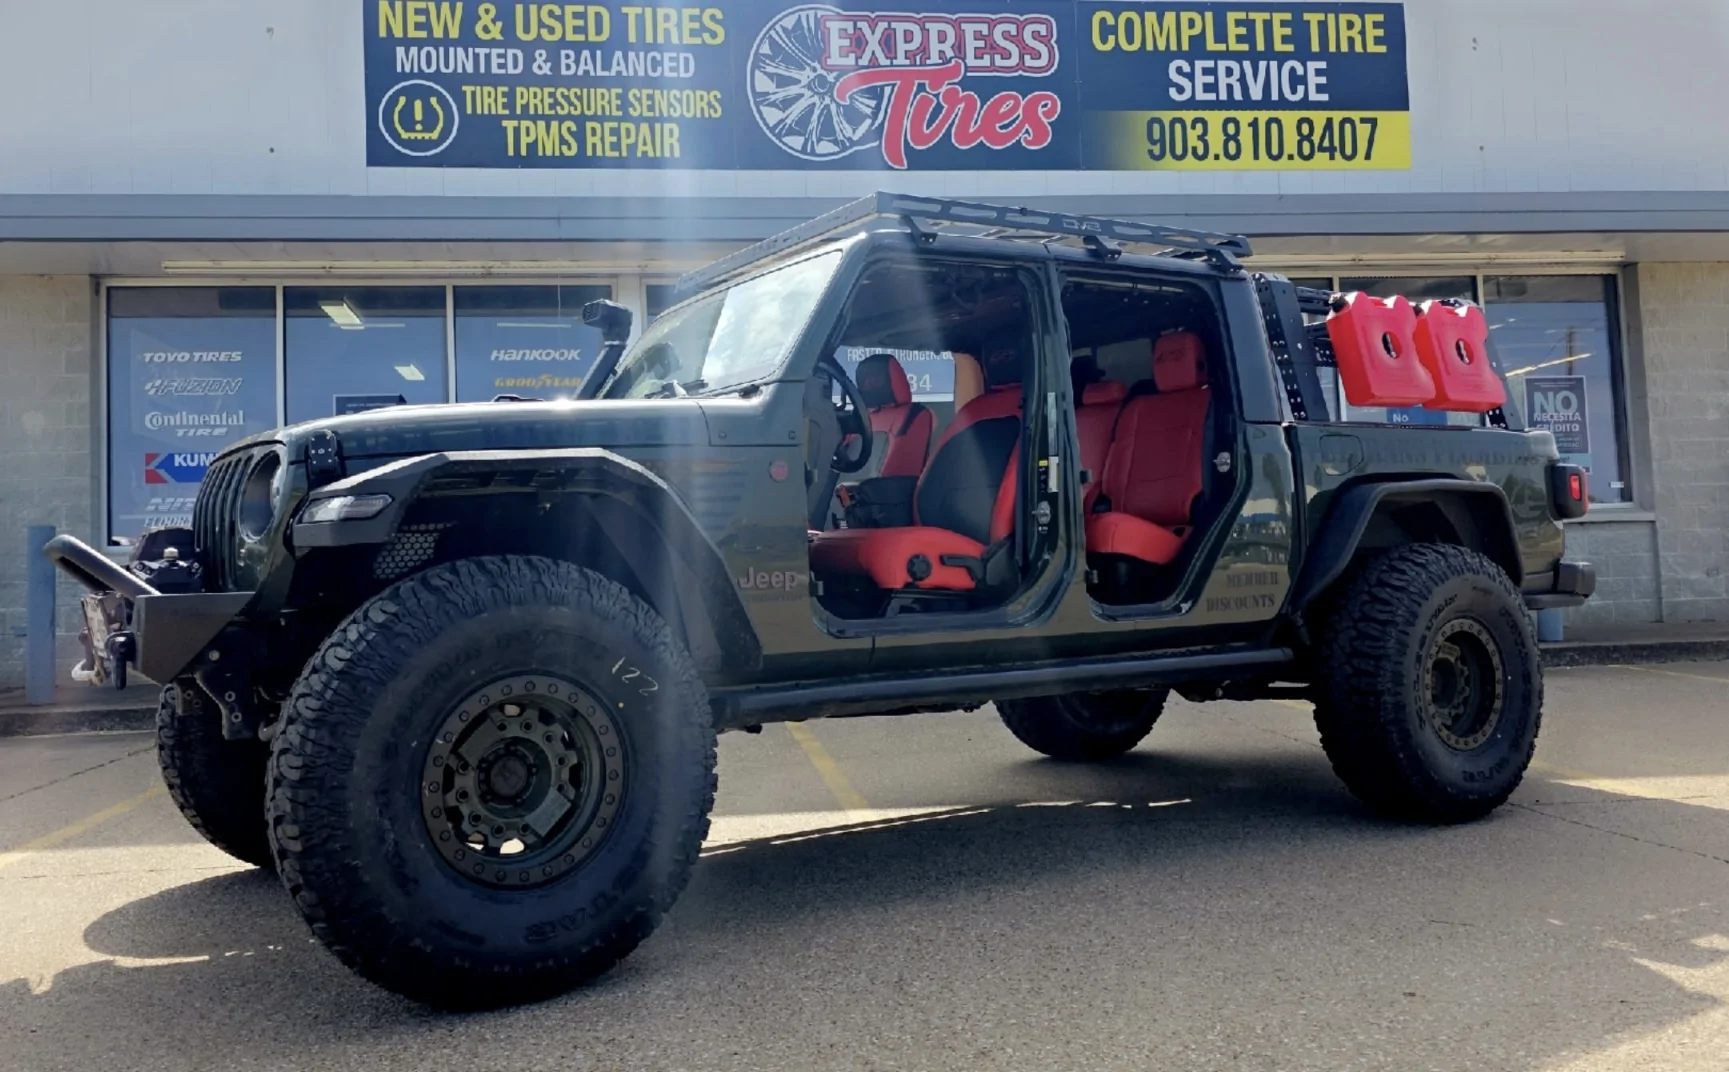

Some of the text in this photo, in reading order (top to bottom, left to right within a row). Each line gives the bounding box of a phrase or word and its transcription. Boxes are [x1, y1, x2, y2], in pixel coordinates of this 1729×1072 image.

[378, 1, 725, 45] NEW & USED TIRES
[1092, 11, 1387, 53] COMPLETE TIRE
[820, 12, 1058, 76] EXPRESS
[396, 47, 695, 78] MOUNTED & BALANCED
[1168, 59, 1329, 102] SERVICE
[462, 86, 722, 118] TIRE PRESSURE SENSORS
[834, 59, 1061, 169] Tires
[502, 120, 680, 158] TPMS REPAIR
[1146, 116, 1379, 161] 903.810.8407
[143, 351, 243, 363] TOYO TIRES
[1533, 390, 1578, 414] NO
[144, 410, 244, 430] Continental
[175, 427, 228, 437] TIRE
[739, 567, 799, 591] Jeep
